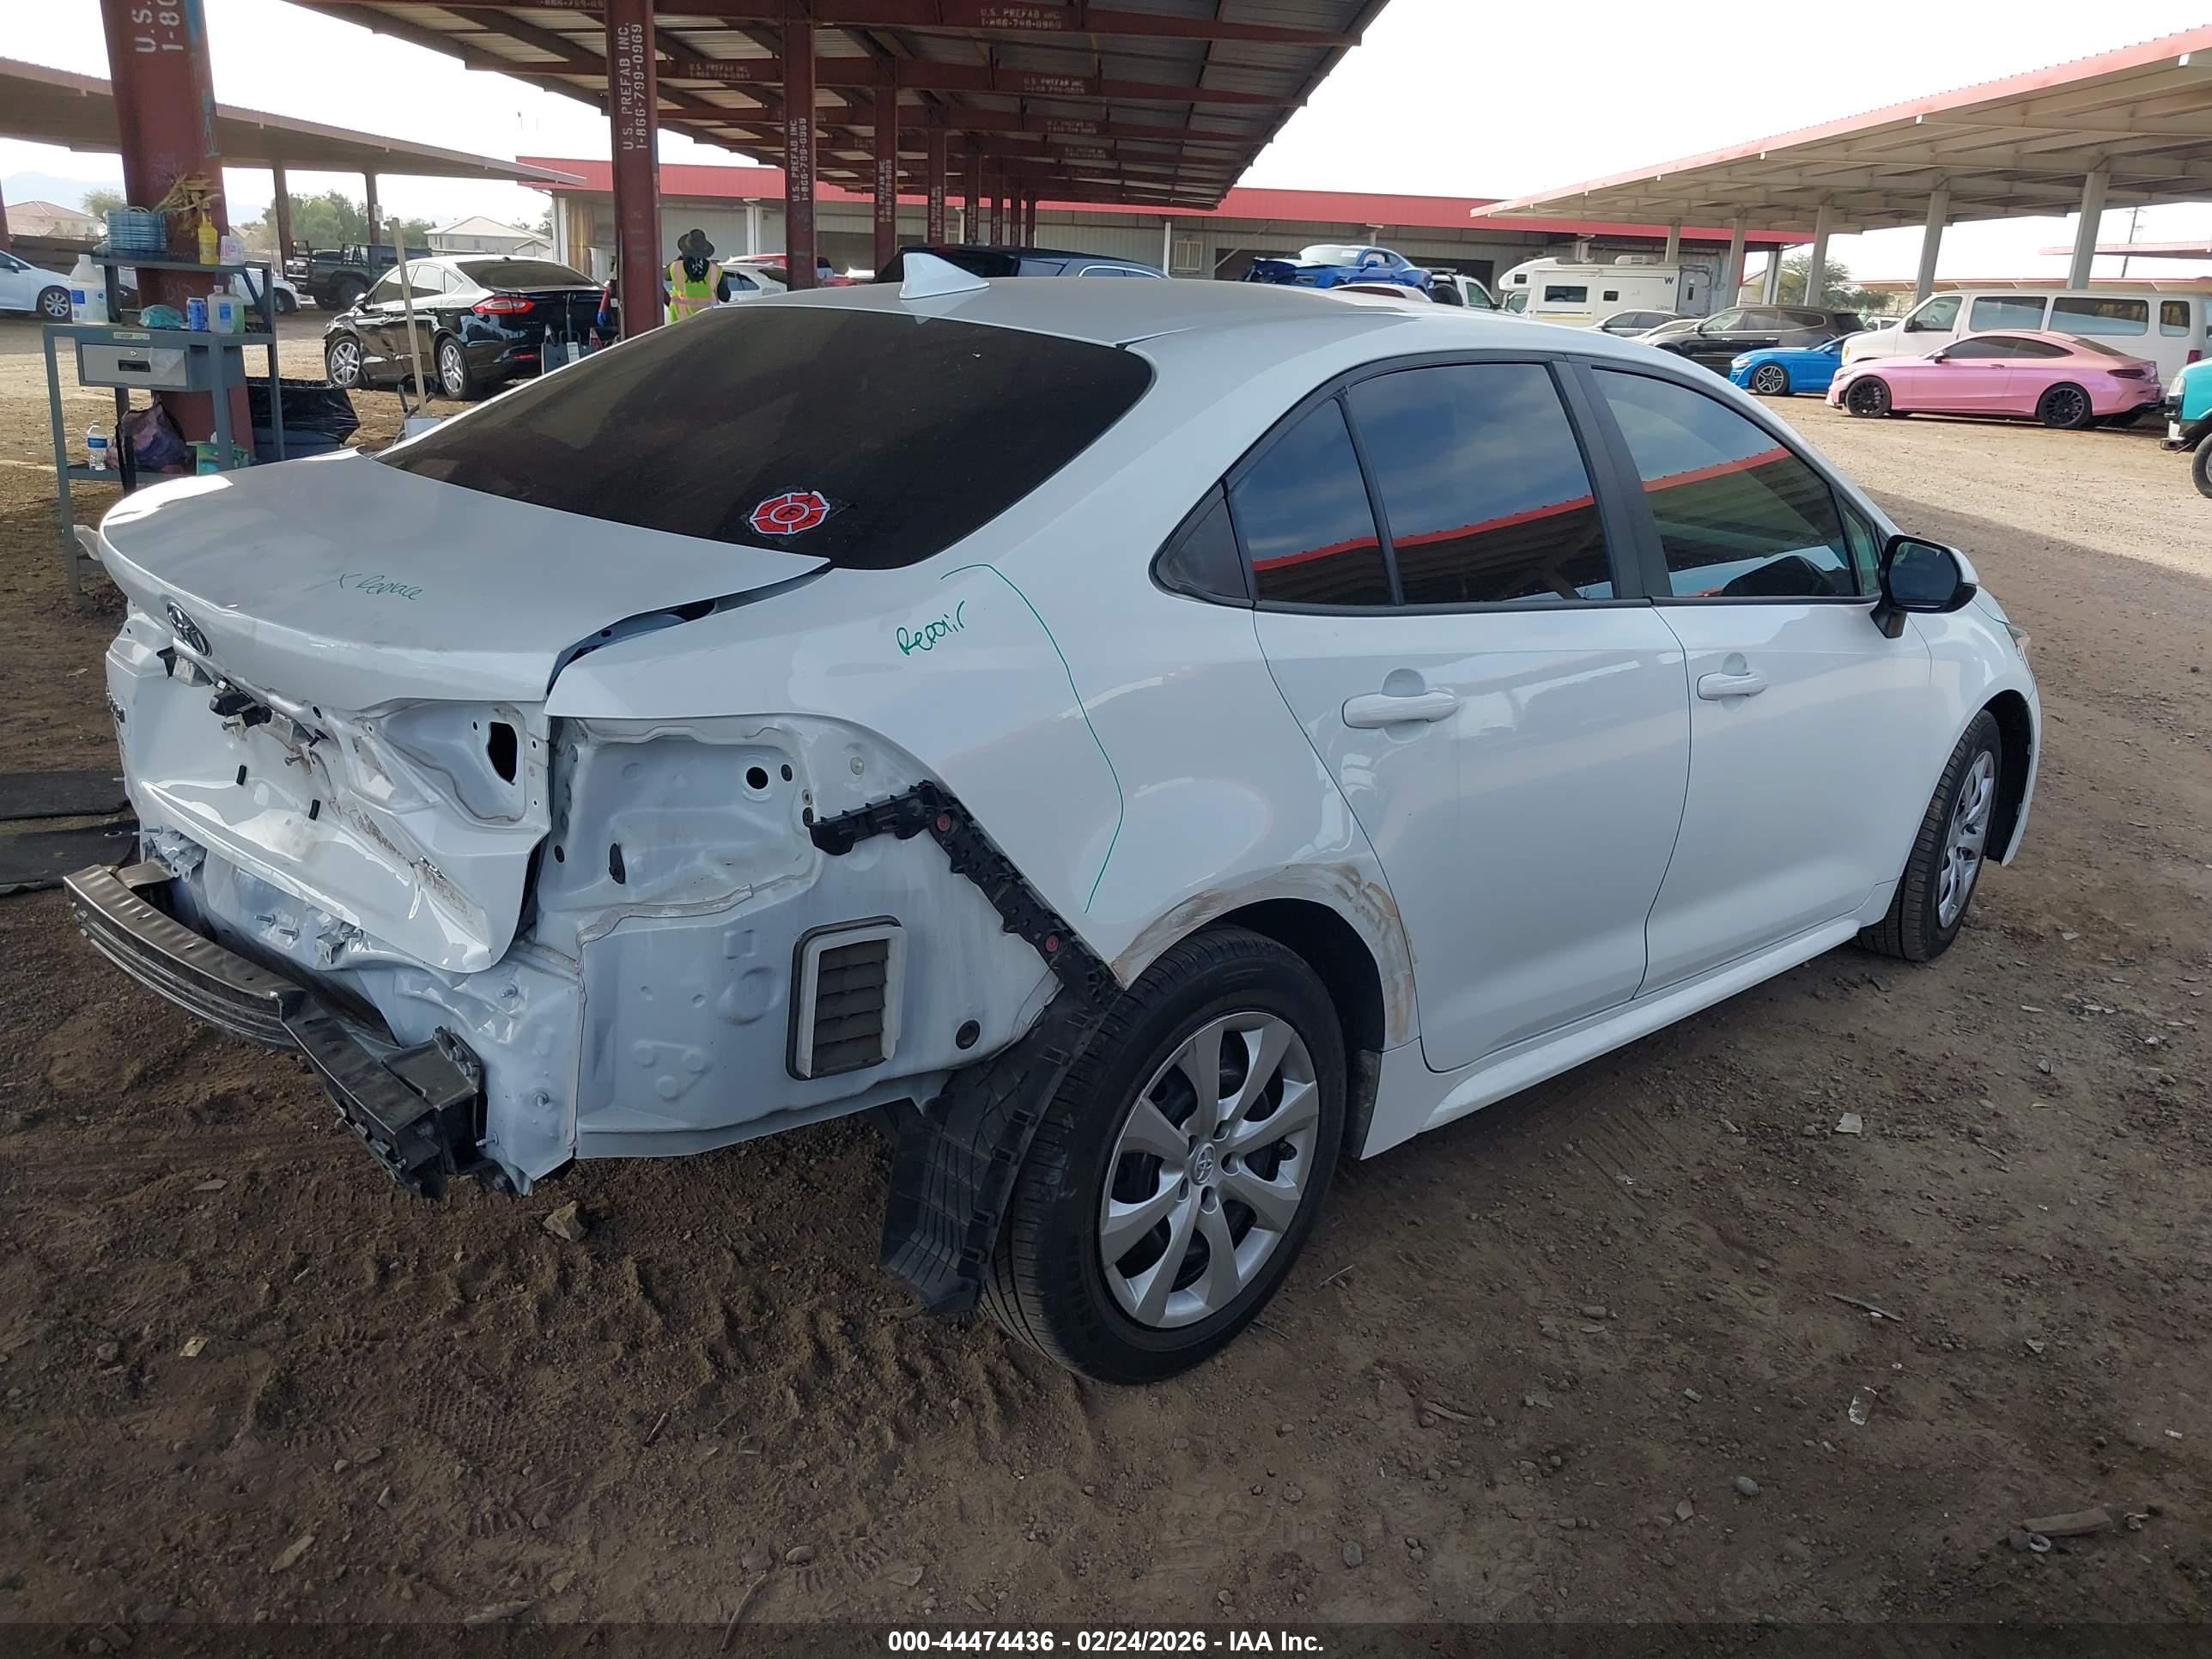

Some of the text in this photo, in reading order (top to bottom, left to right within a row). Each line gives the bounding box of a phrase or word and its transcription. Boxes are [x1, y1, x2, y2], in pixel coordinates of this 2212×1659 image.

[1003, 8, 1040, 18] PREFAB
[618, 22, 634, 150] U.S. PREFAB INC.
[632, 24, 647, 149] 1-866-799-0969
[790, 140, 799, 179] PREFAB
[896, 600, 965, 655] Repair
